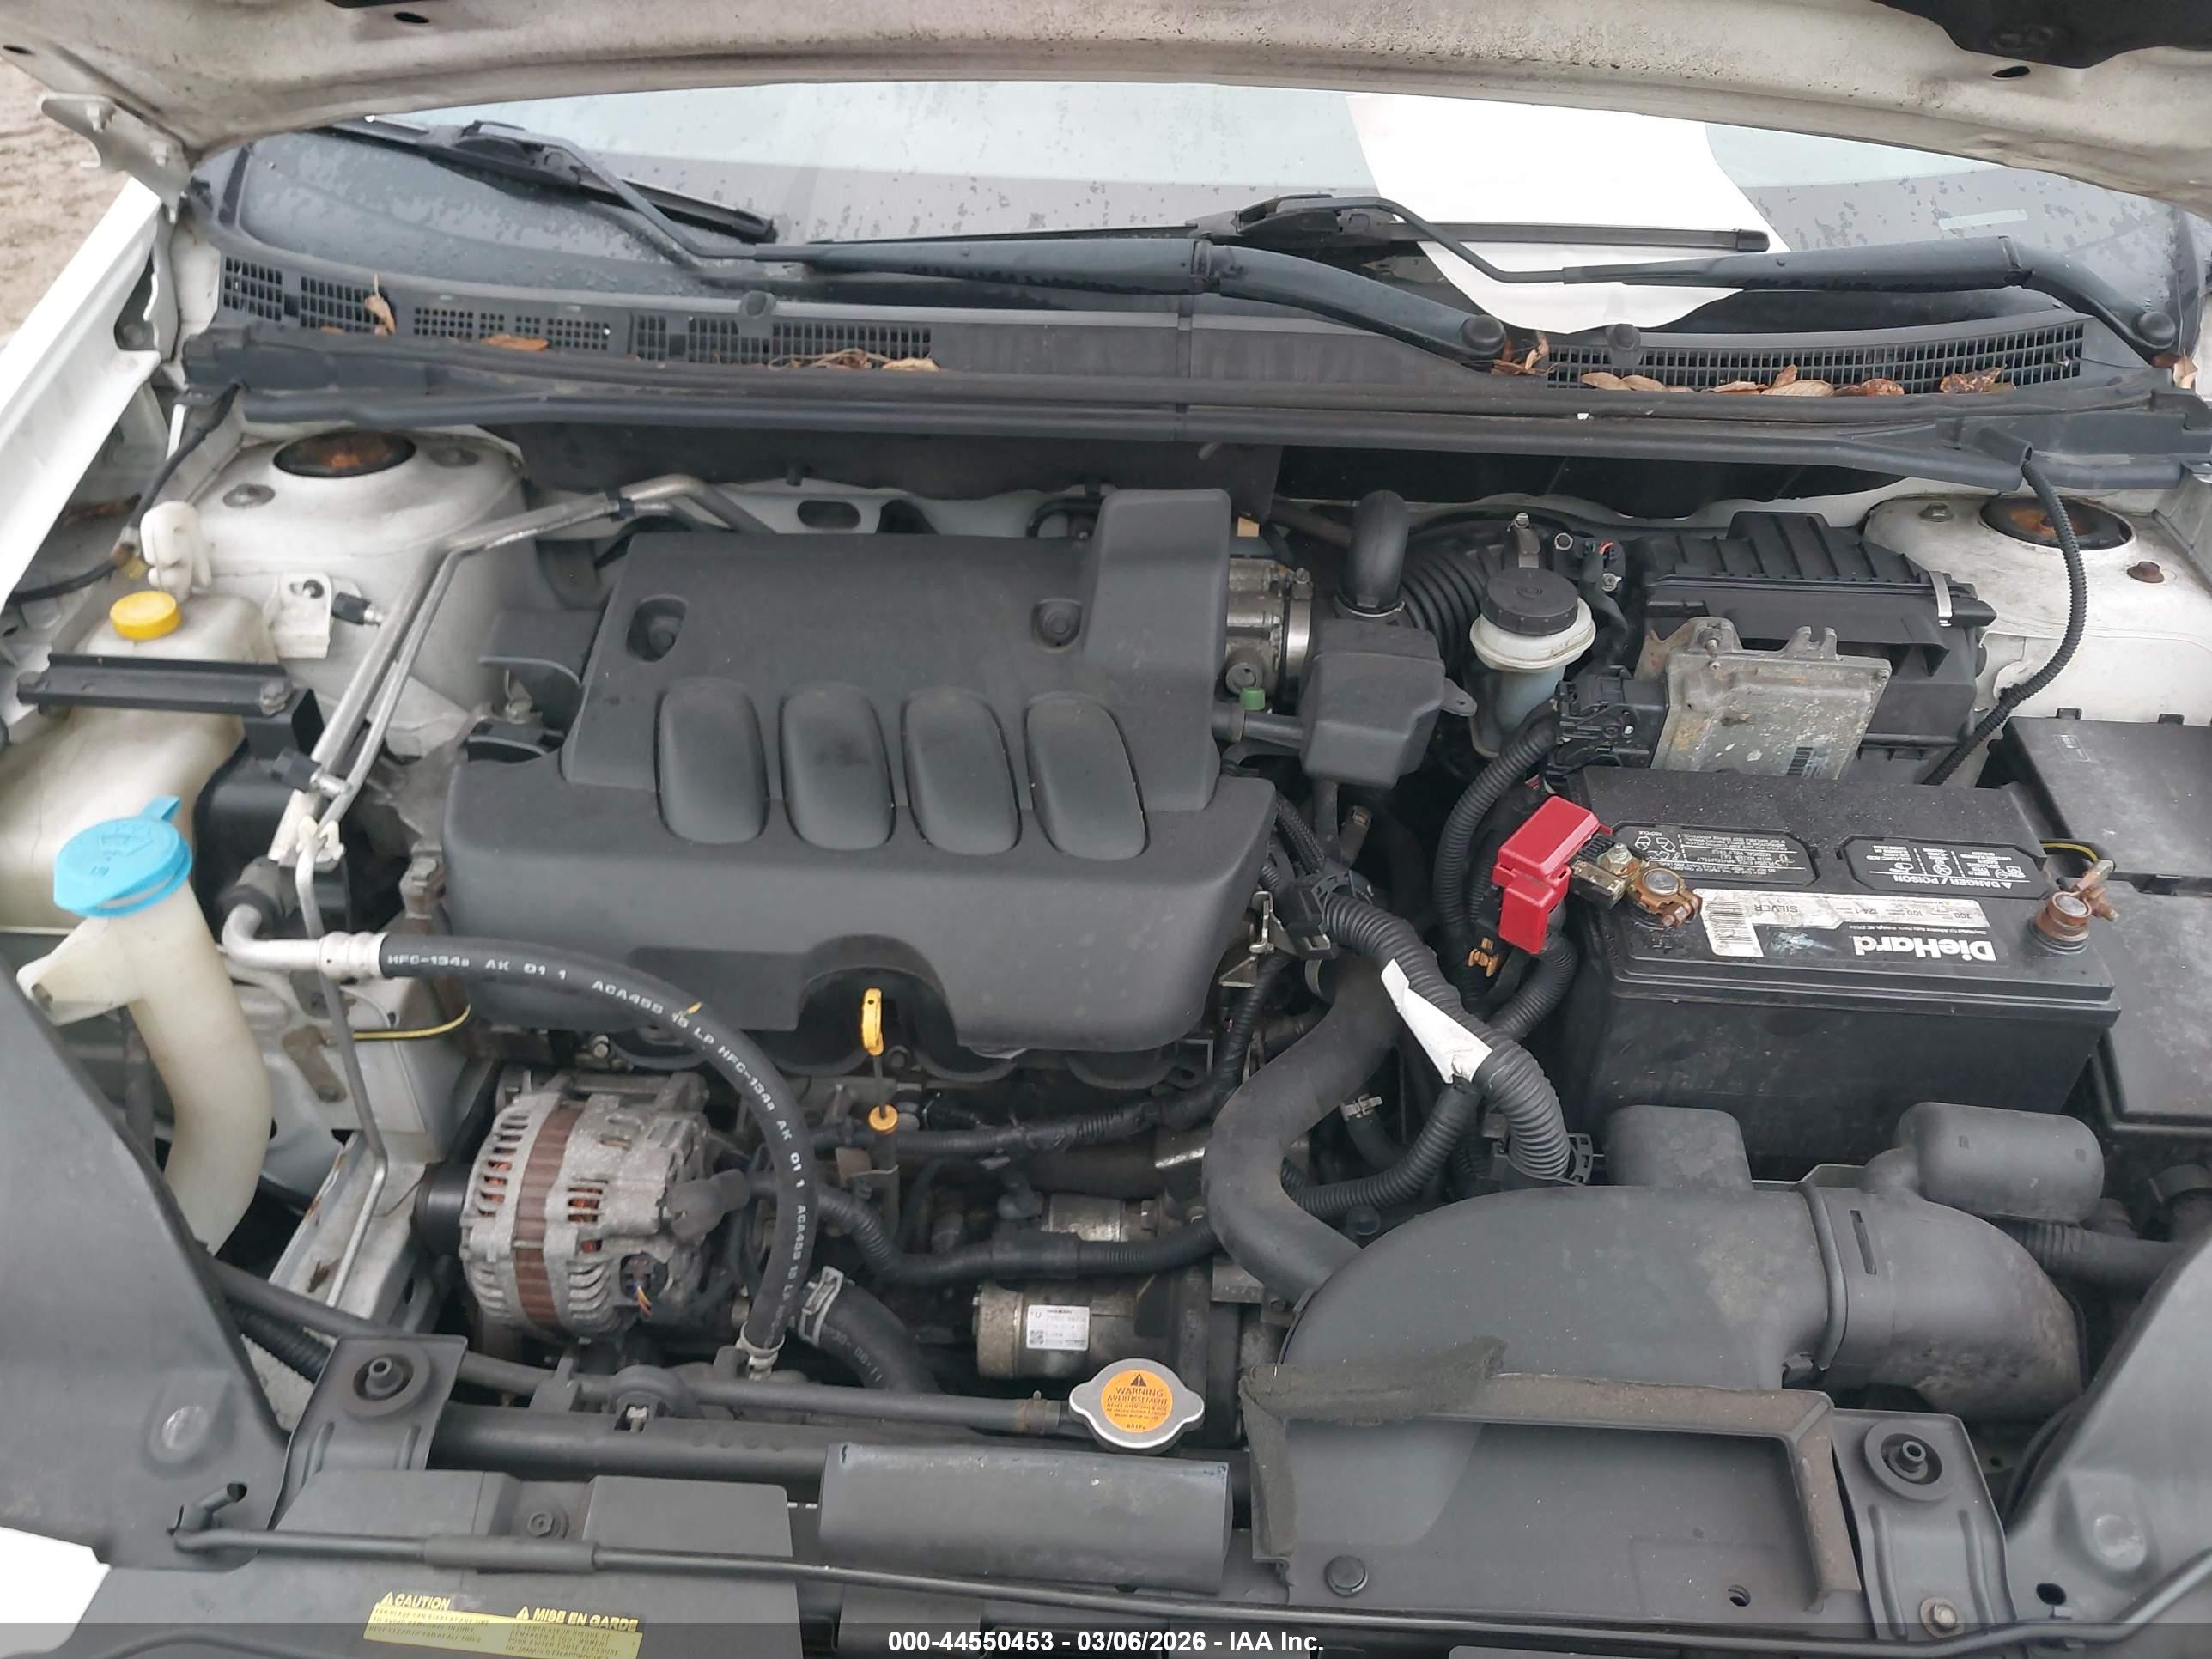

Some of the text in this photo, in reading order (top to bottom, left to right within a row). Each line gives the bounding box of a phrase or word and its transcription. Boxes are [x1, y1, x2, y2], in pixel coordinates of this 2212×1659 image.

[1893, 875, 1940, 884] POISON
[1949, 878, 2001, 888] DANGER
[1853, 936, 1997, 962] DieHard
[387, 954, 471, 967] HFC-134a
[485, 958, 510, 971] AK
[523, 963, 546, 975] 01
[694, 1026, 715, 1044] LP
[717, 1045, 775, 1112] HFC-134a
[776, 1120, 793, 1141] AK
[1116, 1387, 1164, 1397] WARNING
[1107, 1395, 1168, 1406] AVERTISSEMENT
[395, 1594, 451, 1611] CAUTION
[532, 1607, 639, 1632] MISE EN GARDE
